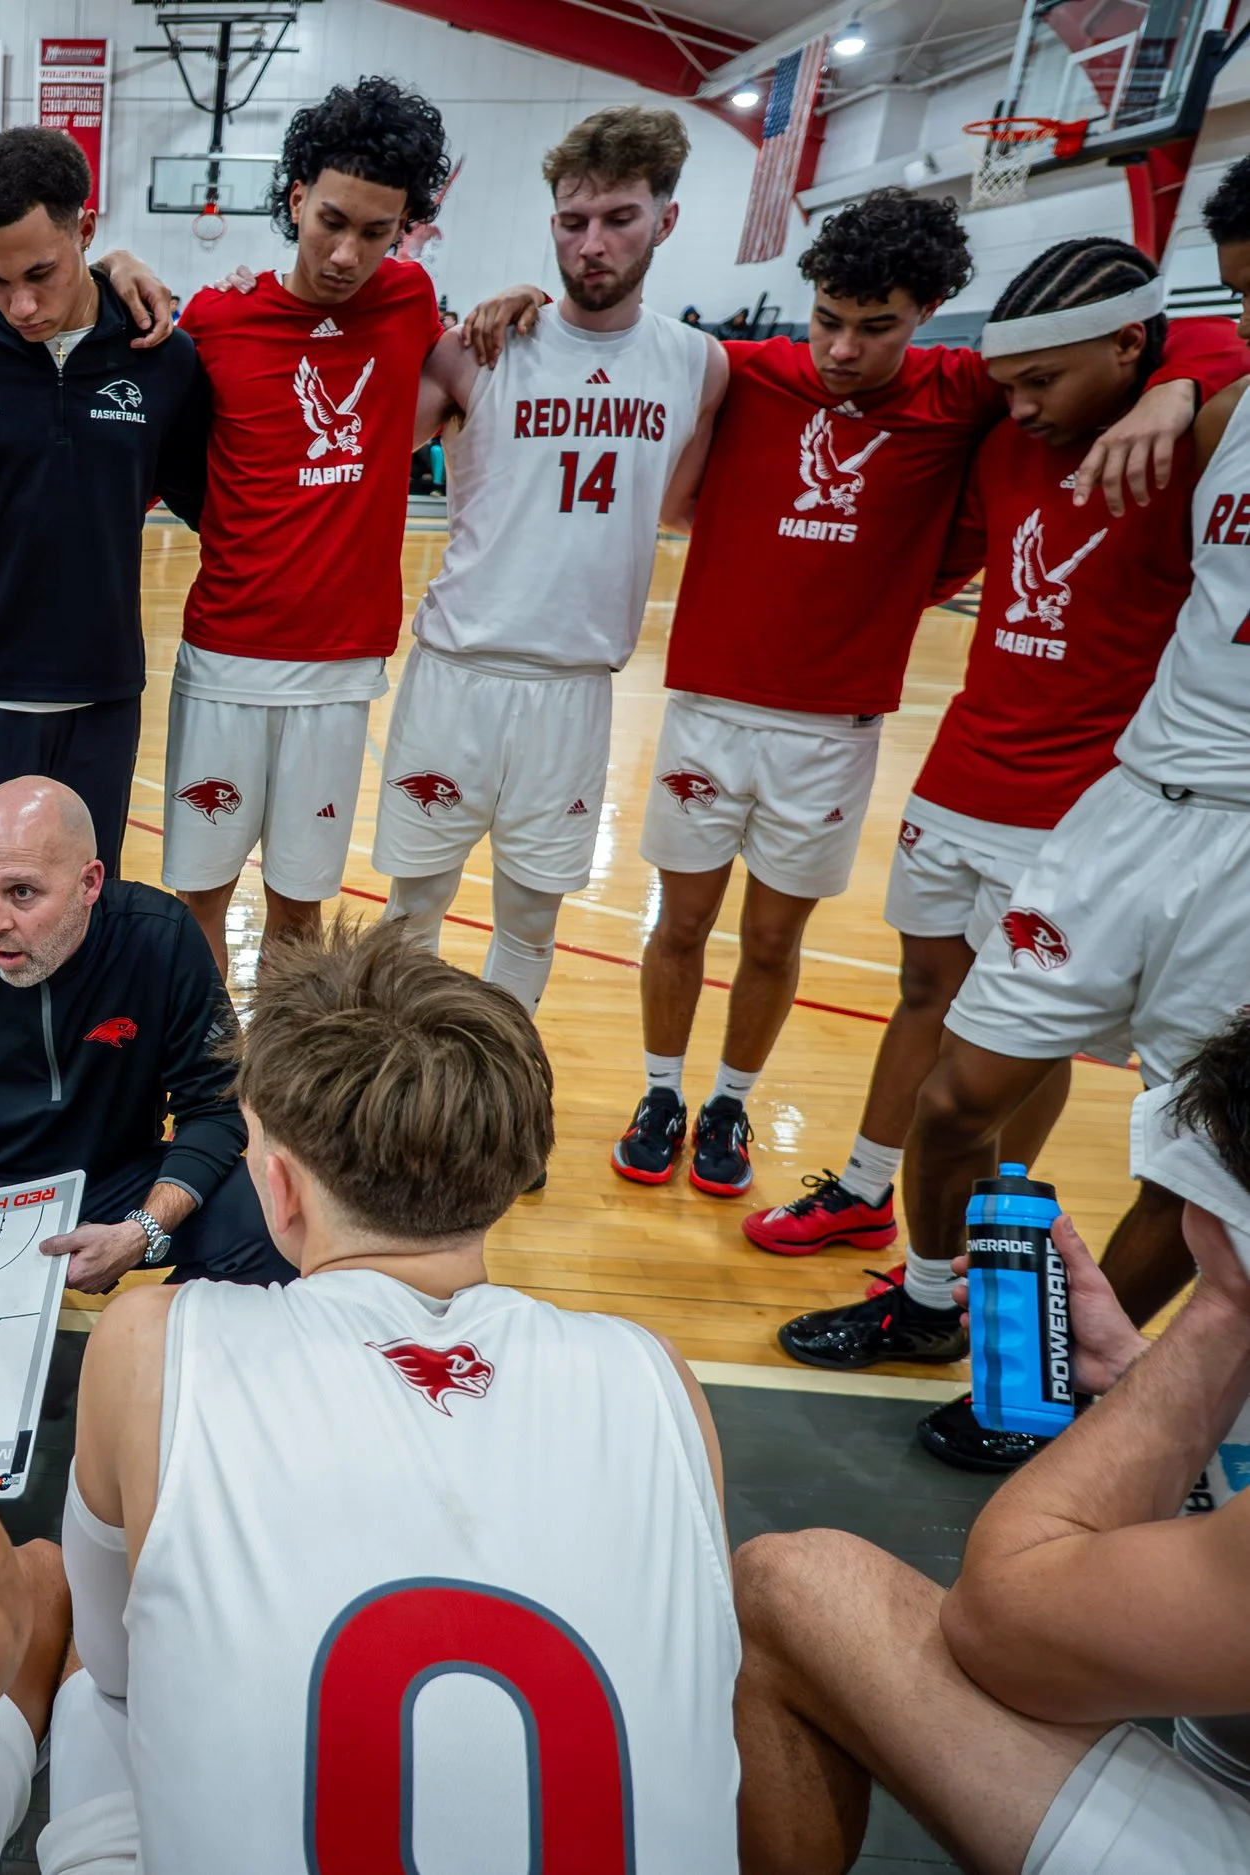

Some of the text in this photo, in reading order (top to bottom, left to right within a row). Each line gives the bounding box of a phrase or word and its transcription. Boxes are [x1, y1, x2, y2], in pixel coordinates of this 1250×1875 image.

[42, 86, 102, 99] CONFERENCE
[42, 100, 101, 113] CHAMPIONS
[90, 409, 146, 423] BASKETBALL
[514, 397, 666, 442] RED HAWKS
[299, 463, 364, 487] HABITS
[558, 451, 618, 514] 14
[778, 517, 858, 543] HABITS
[1202, 493, 1250, 546] RE
[995, 628, 1067, 661] HABITS
[13, 1187, 56, 1207] RED
[966, 1238, 1036, 1255] OWERADE
[303, 1576, 636, 1875] 0
